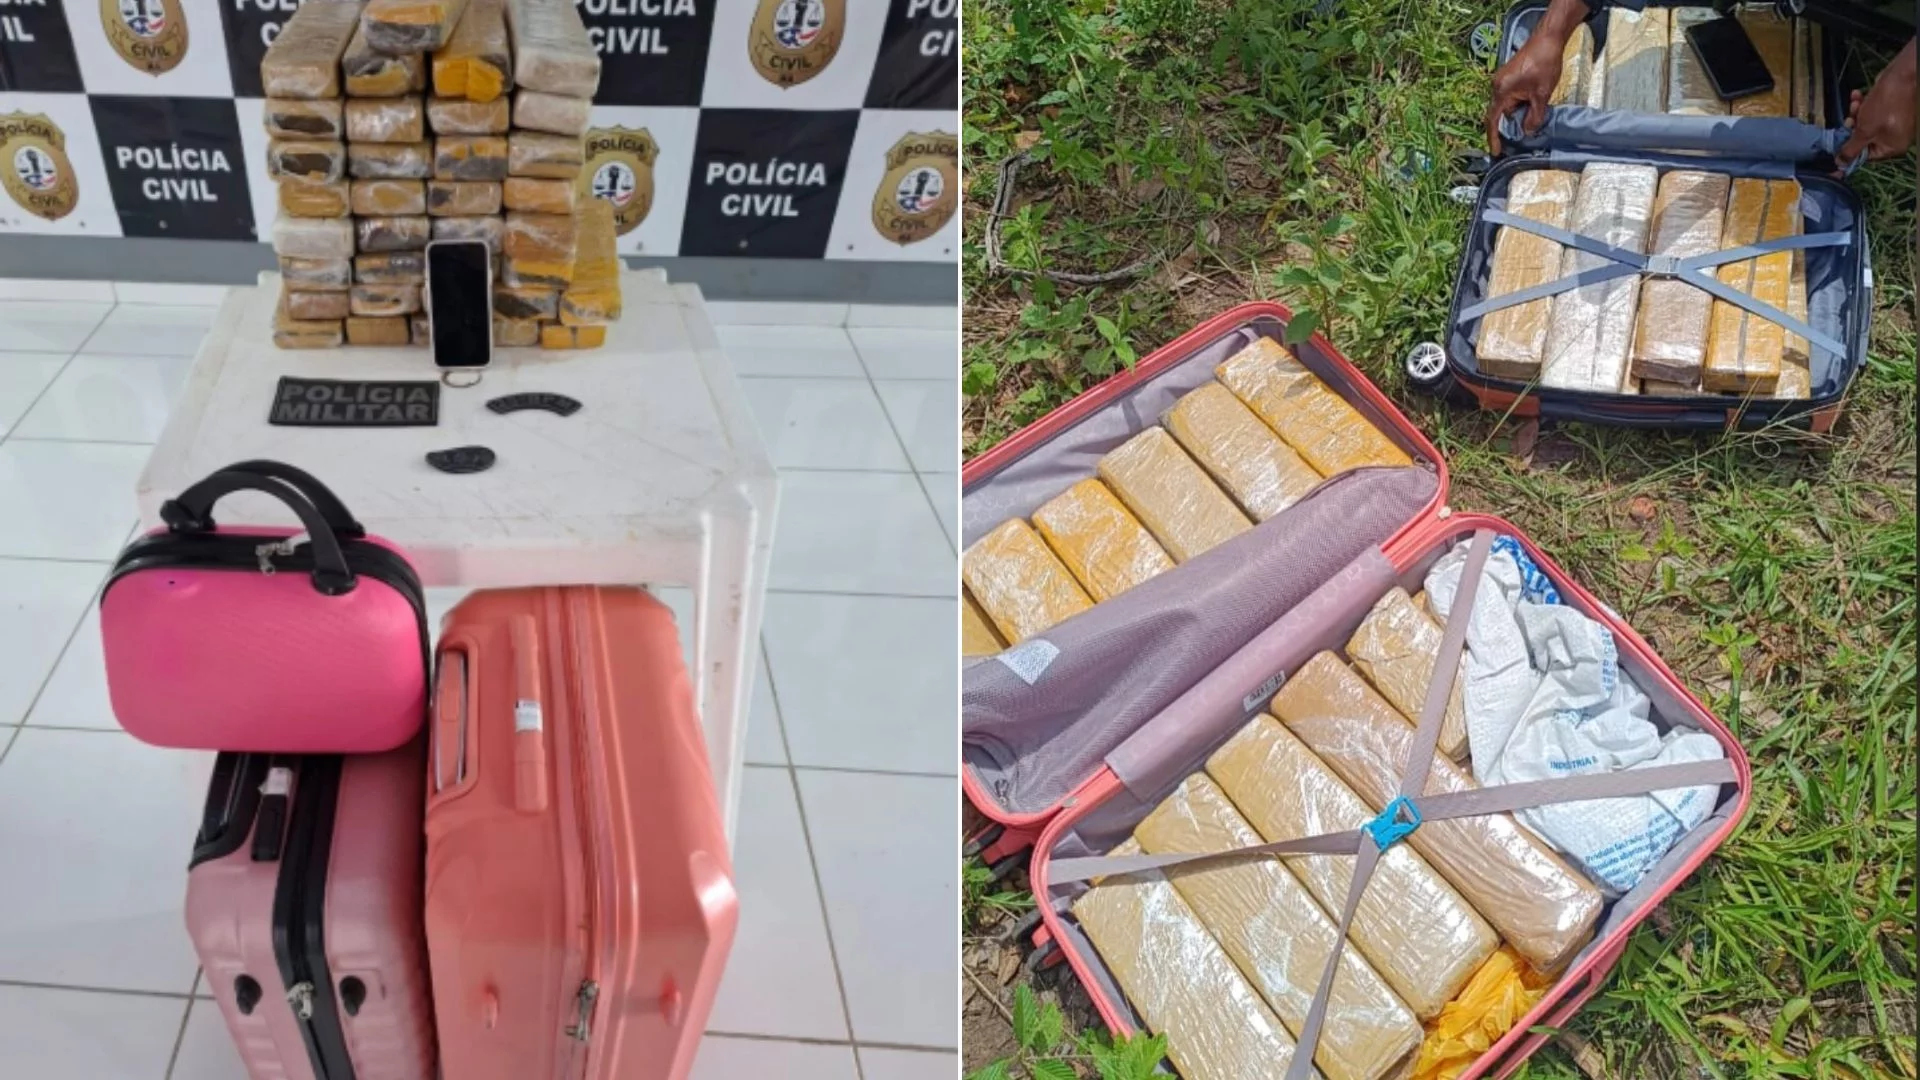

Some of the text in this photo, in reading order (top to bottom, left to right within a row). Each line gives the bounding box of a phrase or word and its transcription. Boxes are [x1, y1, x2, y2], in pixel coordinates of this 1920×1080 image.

[906, 0, 958, 18] PO
[131, 42, 170, 57] CIVIL
[587, 27, 669, 54] CIVIL
[768, 54, 812, 70] CIVIL
[116, 142, 231, 172] POLÍCIA
[706, 158, 826, 186] POLÍCIA
[142, 177, 218, 201] CIVIL
[721, 193, 799, 217] CIVIL
[279, 383, 431, 403] POLÍCIA
[277, 402, 430, 421] MILITAR
